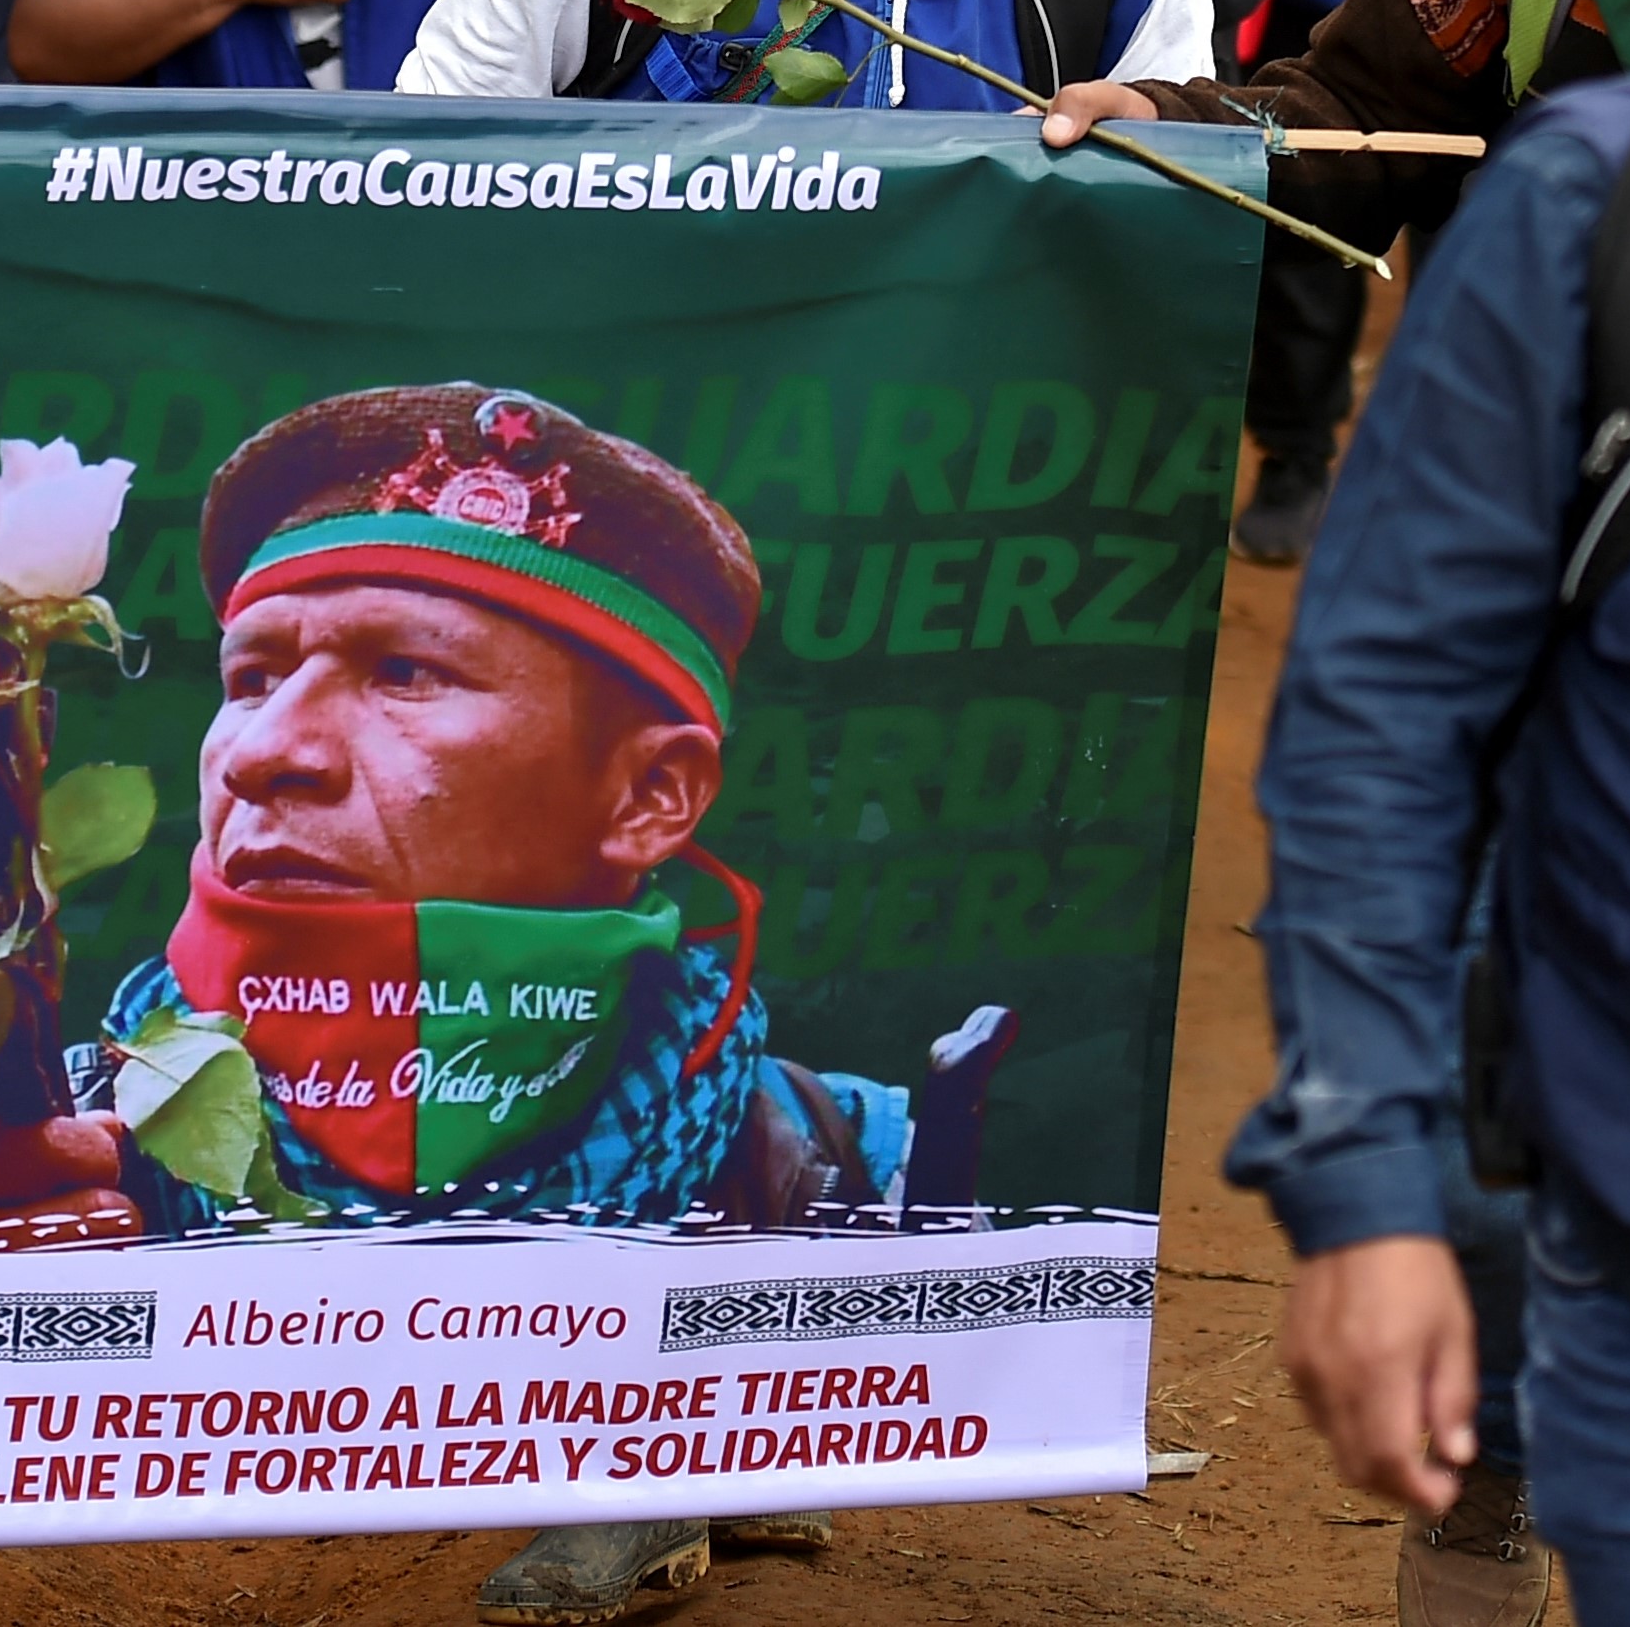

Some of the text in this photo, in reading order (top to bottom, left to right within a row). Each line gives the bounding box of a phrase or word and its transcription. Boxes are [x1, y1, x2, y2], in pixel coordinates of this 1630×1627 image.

[46, 146, 882, 212] #NuestraCausaEsLaVida
[370, 979, 490, 1017] WALA
[508, 984, 598, 1021] KIWE
[389, 1038, 495, 1105] Vida
[183, 1296, 628, 1348] Albeiro Camayo
[4, 1394, 79, 1443] TU
[93, 1385, 370, 1439] RETORNO
[380, 1385, 419, 1430] A
[436, 1381, 504, 1429] LA
[518, 1375, 722, 1426] MADRE
[737, 1363, 931, 1416] TIERRA
[133, 1448, 211, 1499] DE
[223, 1440, 541, 1495] FORTALEZA
[562, 1437, 597, 1482] Y
[607, 1414, 989, 1479] SOLIDARIDAD
